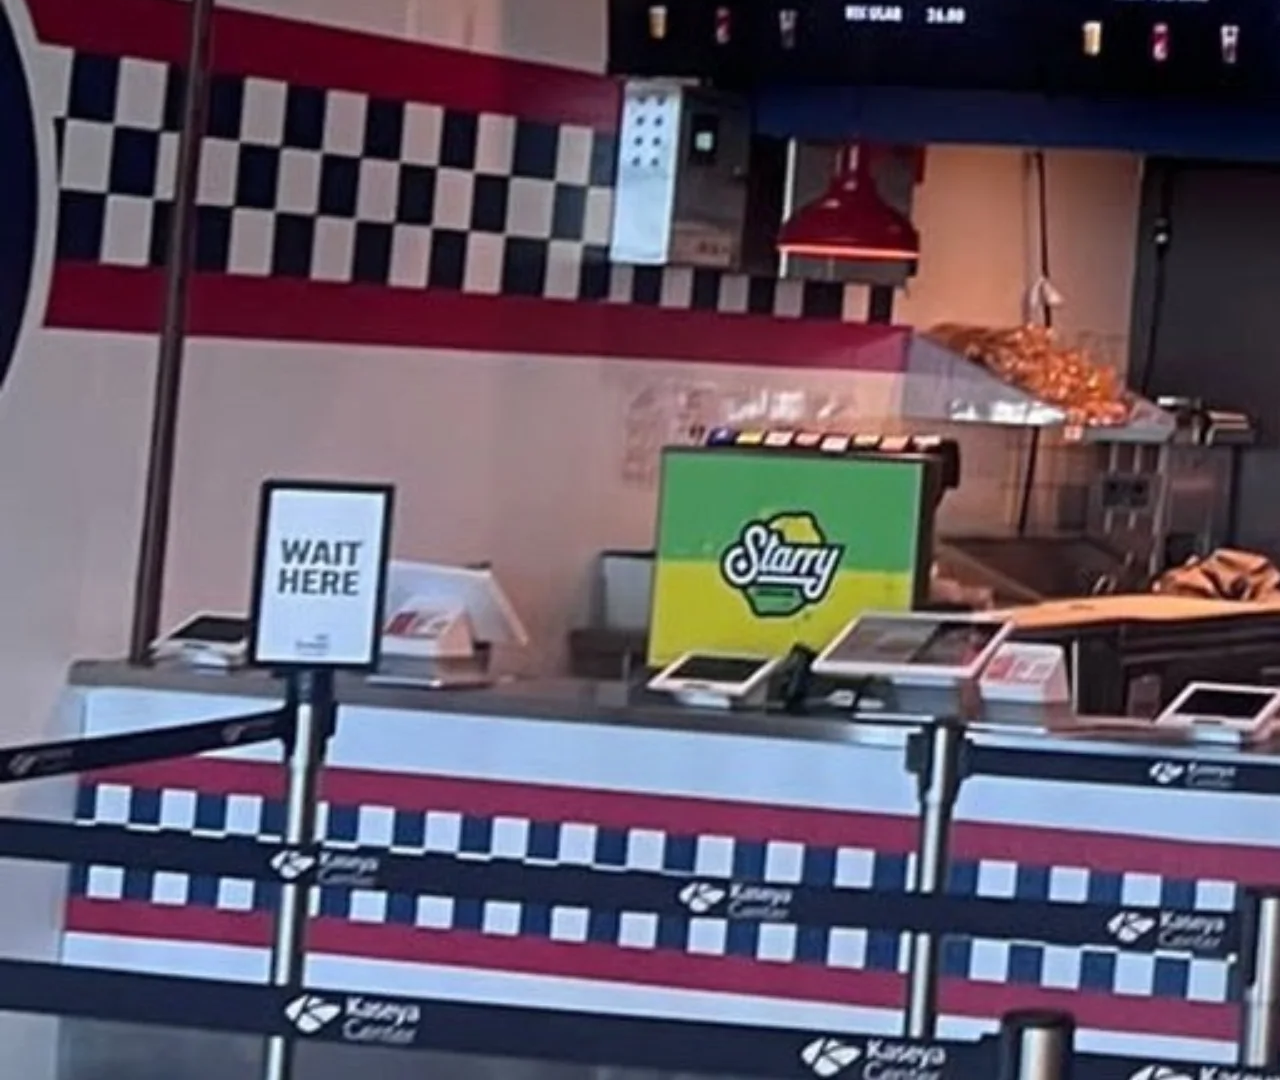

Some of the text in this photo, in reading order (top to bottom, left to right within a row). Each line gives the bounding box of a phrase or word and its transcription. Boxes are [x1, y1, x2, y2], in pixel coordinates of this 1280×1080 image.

[281, 539, 362, 566] WAIT
[724, 524, 840, 600] Starry
[277, 568, 360, 596] HERE
[346, 996, 421, 1027] Kaseya
[866, 1038, 946, 1068] Kaseya
